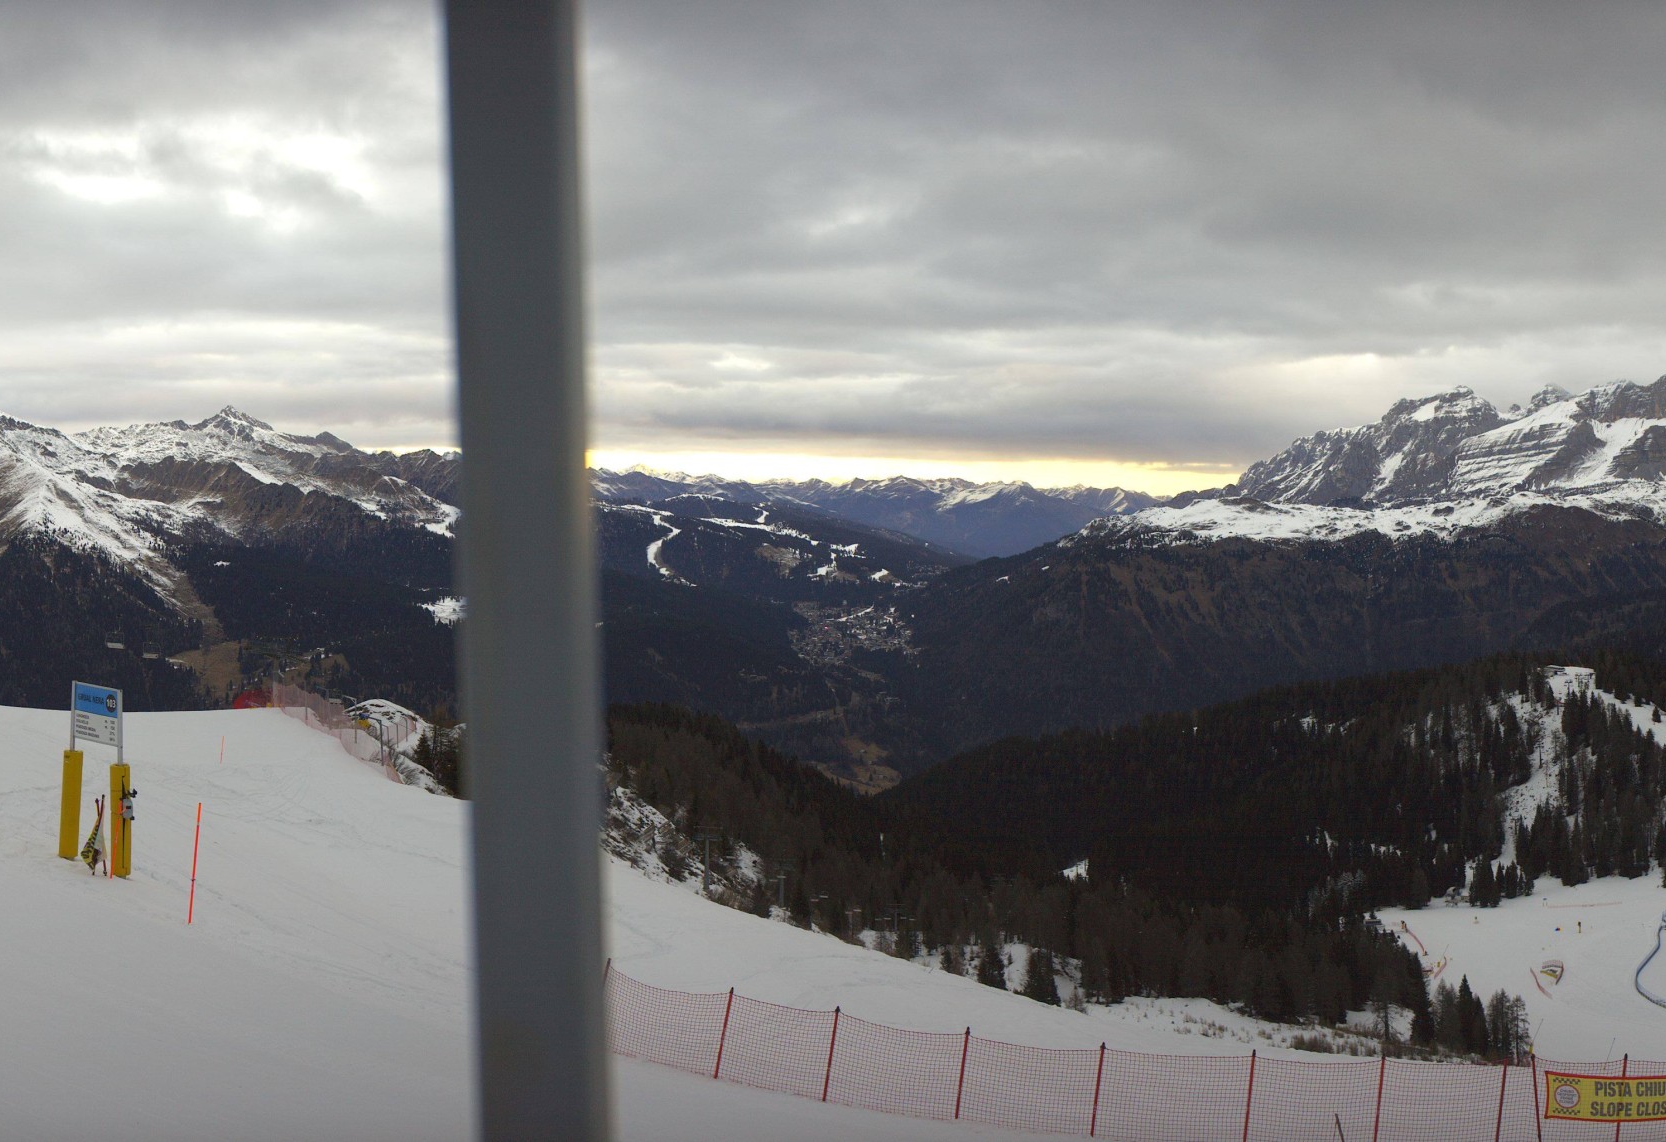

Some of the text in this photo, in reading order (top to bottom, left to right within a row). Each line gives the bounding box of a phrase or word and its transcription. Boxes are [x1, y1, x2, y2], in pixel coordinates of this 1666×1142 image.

[106, 698, 116, 709] 103
[1594, 1080, 1632, 1098] PISTA
[1590, 1101, 1632, 1117] SLOPE
